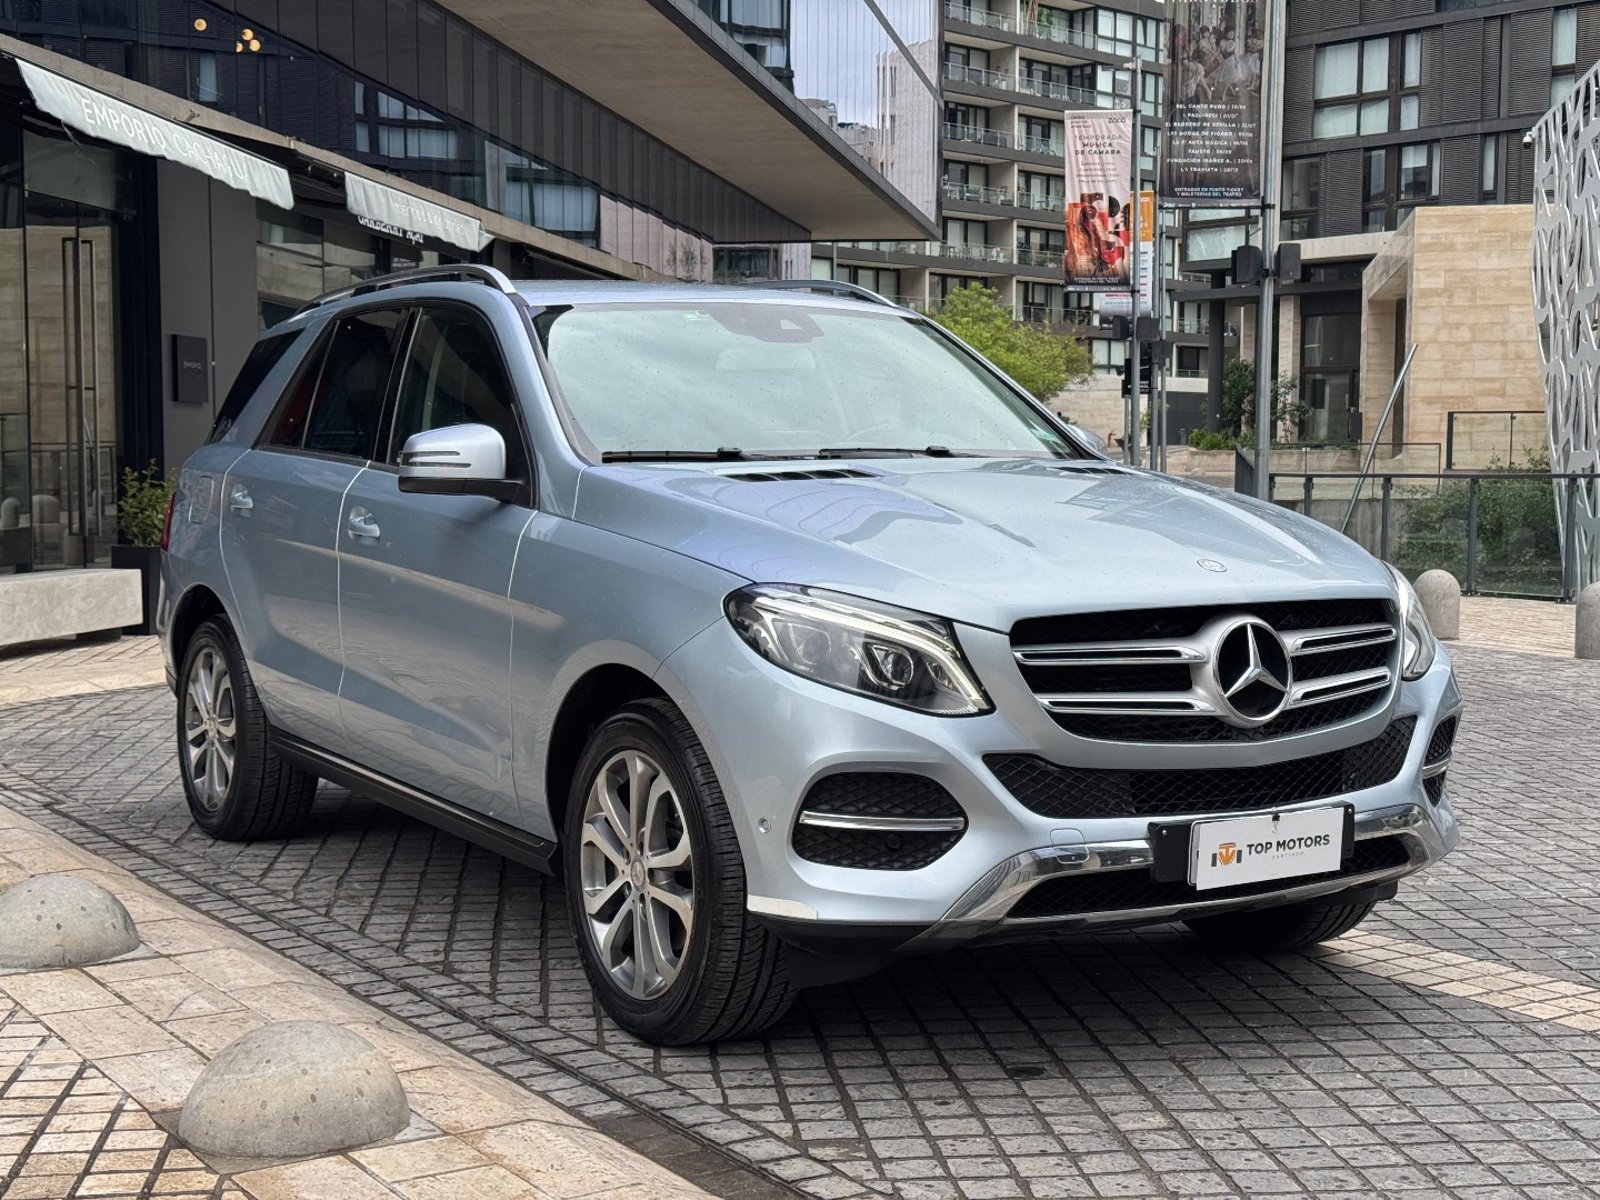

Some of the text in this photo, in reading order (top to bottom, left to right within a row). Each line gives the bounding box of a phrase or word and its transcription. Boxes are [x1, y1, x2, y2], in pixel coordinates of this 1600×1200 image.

[81, 98, 248, 180] EMPORIO CACHAGU
[1246, 834, 1330, 855] TOP MOTORS
